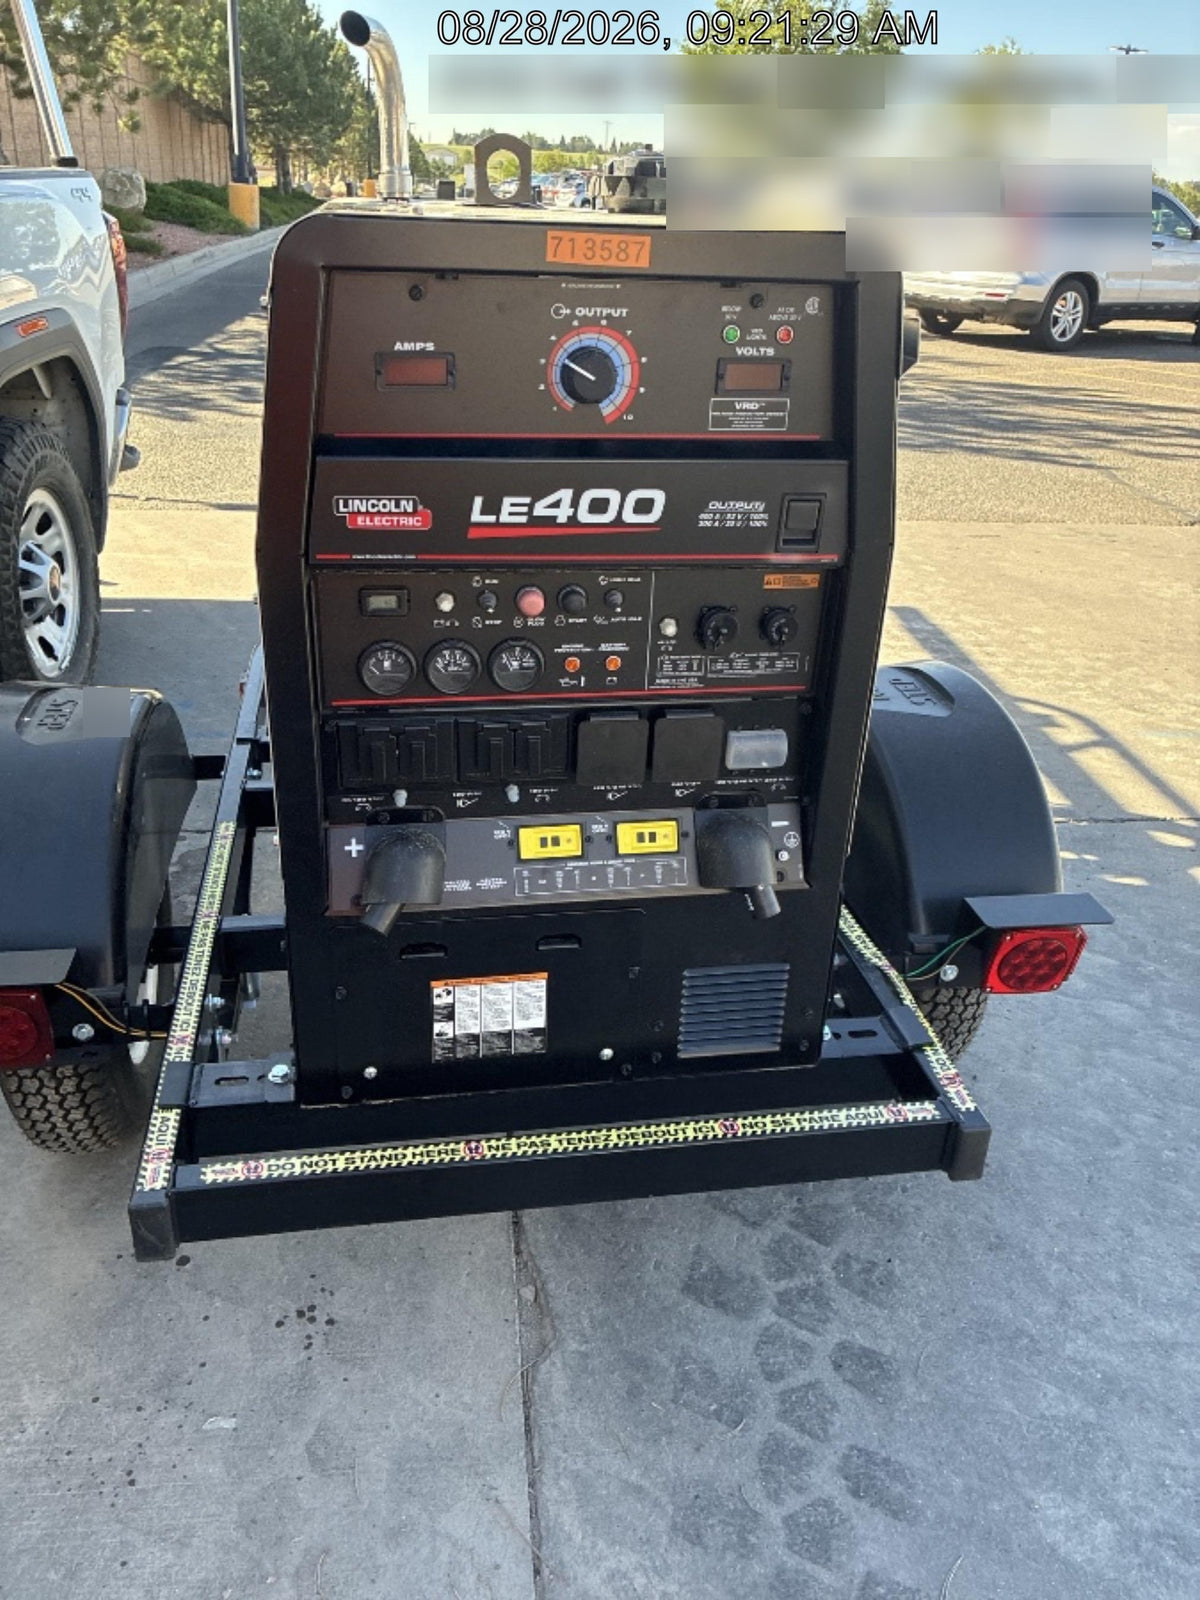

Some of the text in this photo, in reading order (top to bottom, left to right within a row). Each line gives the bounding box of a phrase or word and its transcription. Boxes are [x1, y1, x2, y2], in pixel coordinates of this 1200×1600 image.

[550, 236, 646, 263] 713587
[575, 307, 629, 317] OUTPUT
[394, 341, 435, 351] AMPS
[735, 346, 775, 356] VOLTS
[339, 499, 414, 513] LINCOLN
[470, 489, 666, 524] LE400
[357, 515, 422, 526] ELECTRIC
[741, 1120, 767, 1130] NO
[771, 1117, 794, 1128] SE
[487, 1124, 715, 1152] NE PAS TENEZ DEBOUT ICI
[267, 1148, 461, 1173] DO NOT STAND HERE
